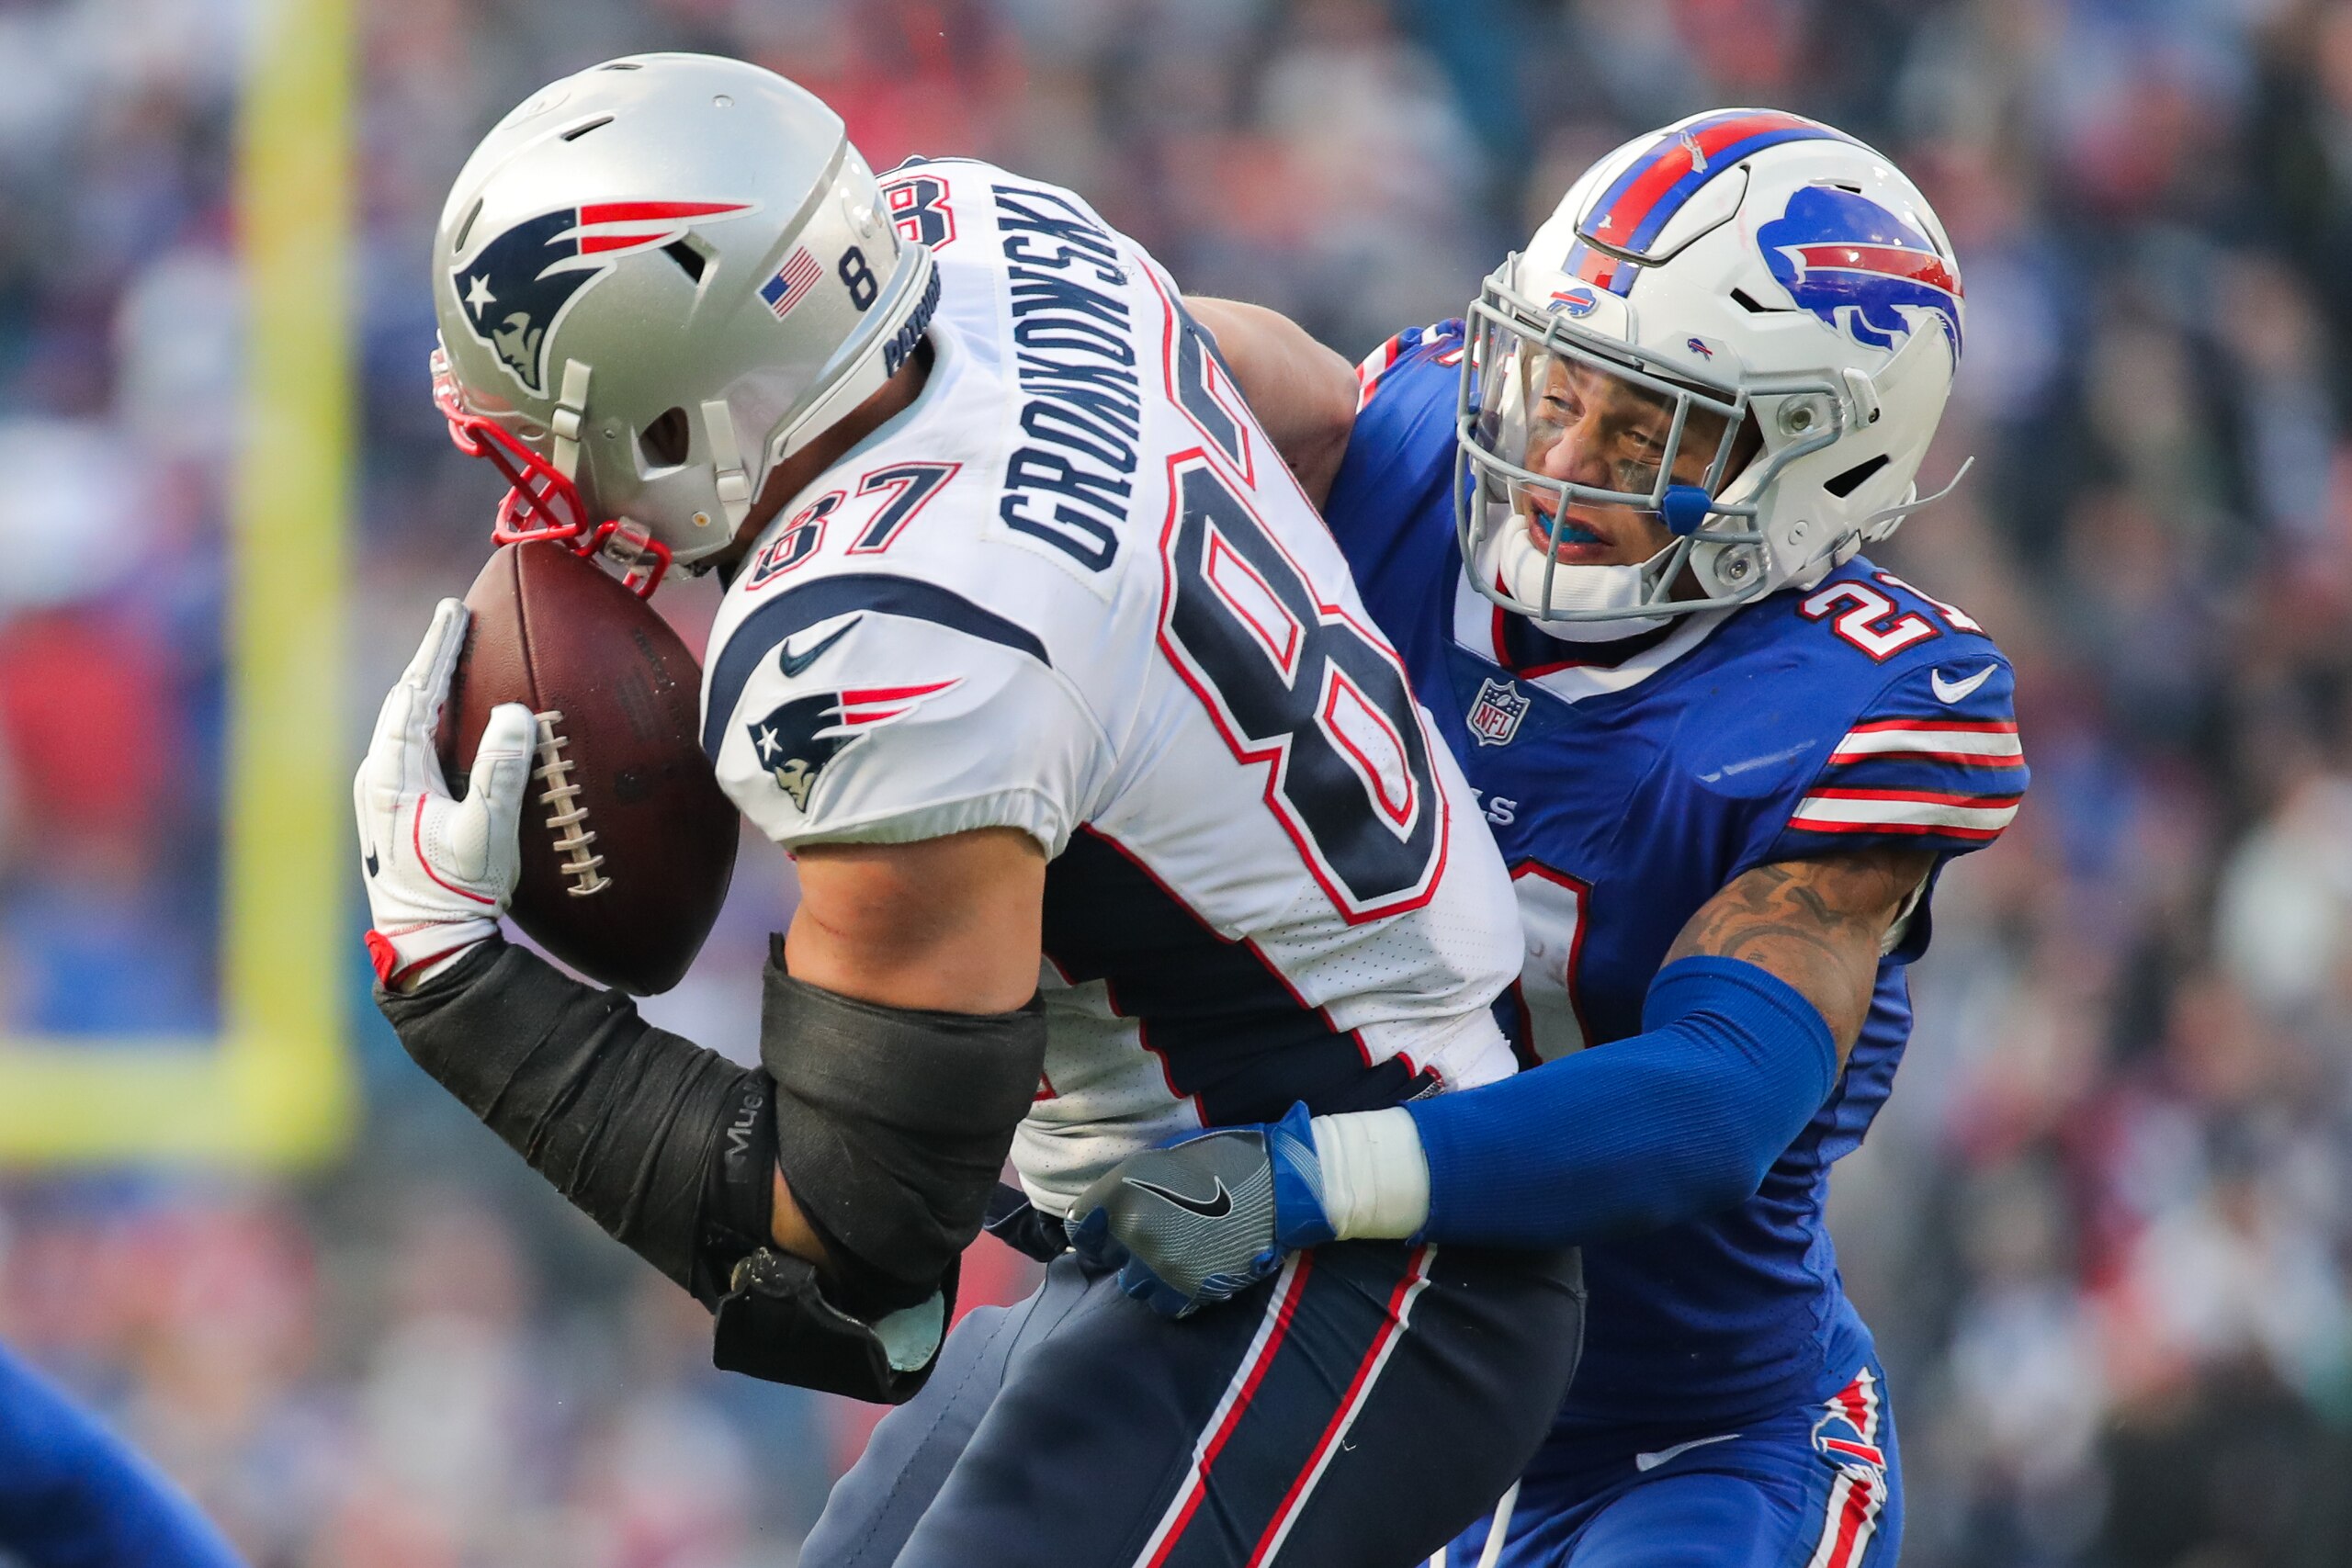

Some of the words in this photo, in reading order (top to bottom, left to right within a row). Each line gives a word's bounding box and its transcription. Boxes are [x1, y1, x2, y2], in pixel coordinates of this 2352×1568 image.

[837, 246, 879, 312] 8
[989, 184, 1143, 573] GRONKOWSKI
[747, 461, 963, 591] 87
[1475, 704, 1510, 737] NFL
